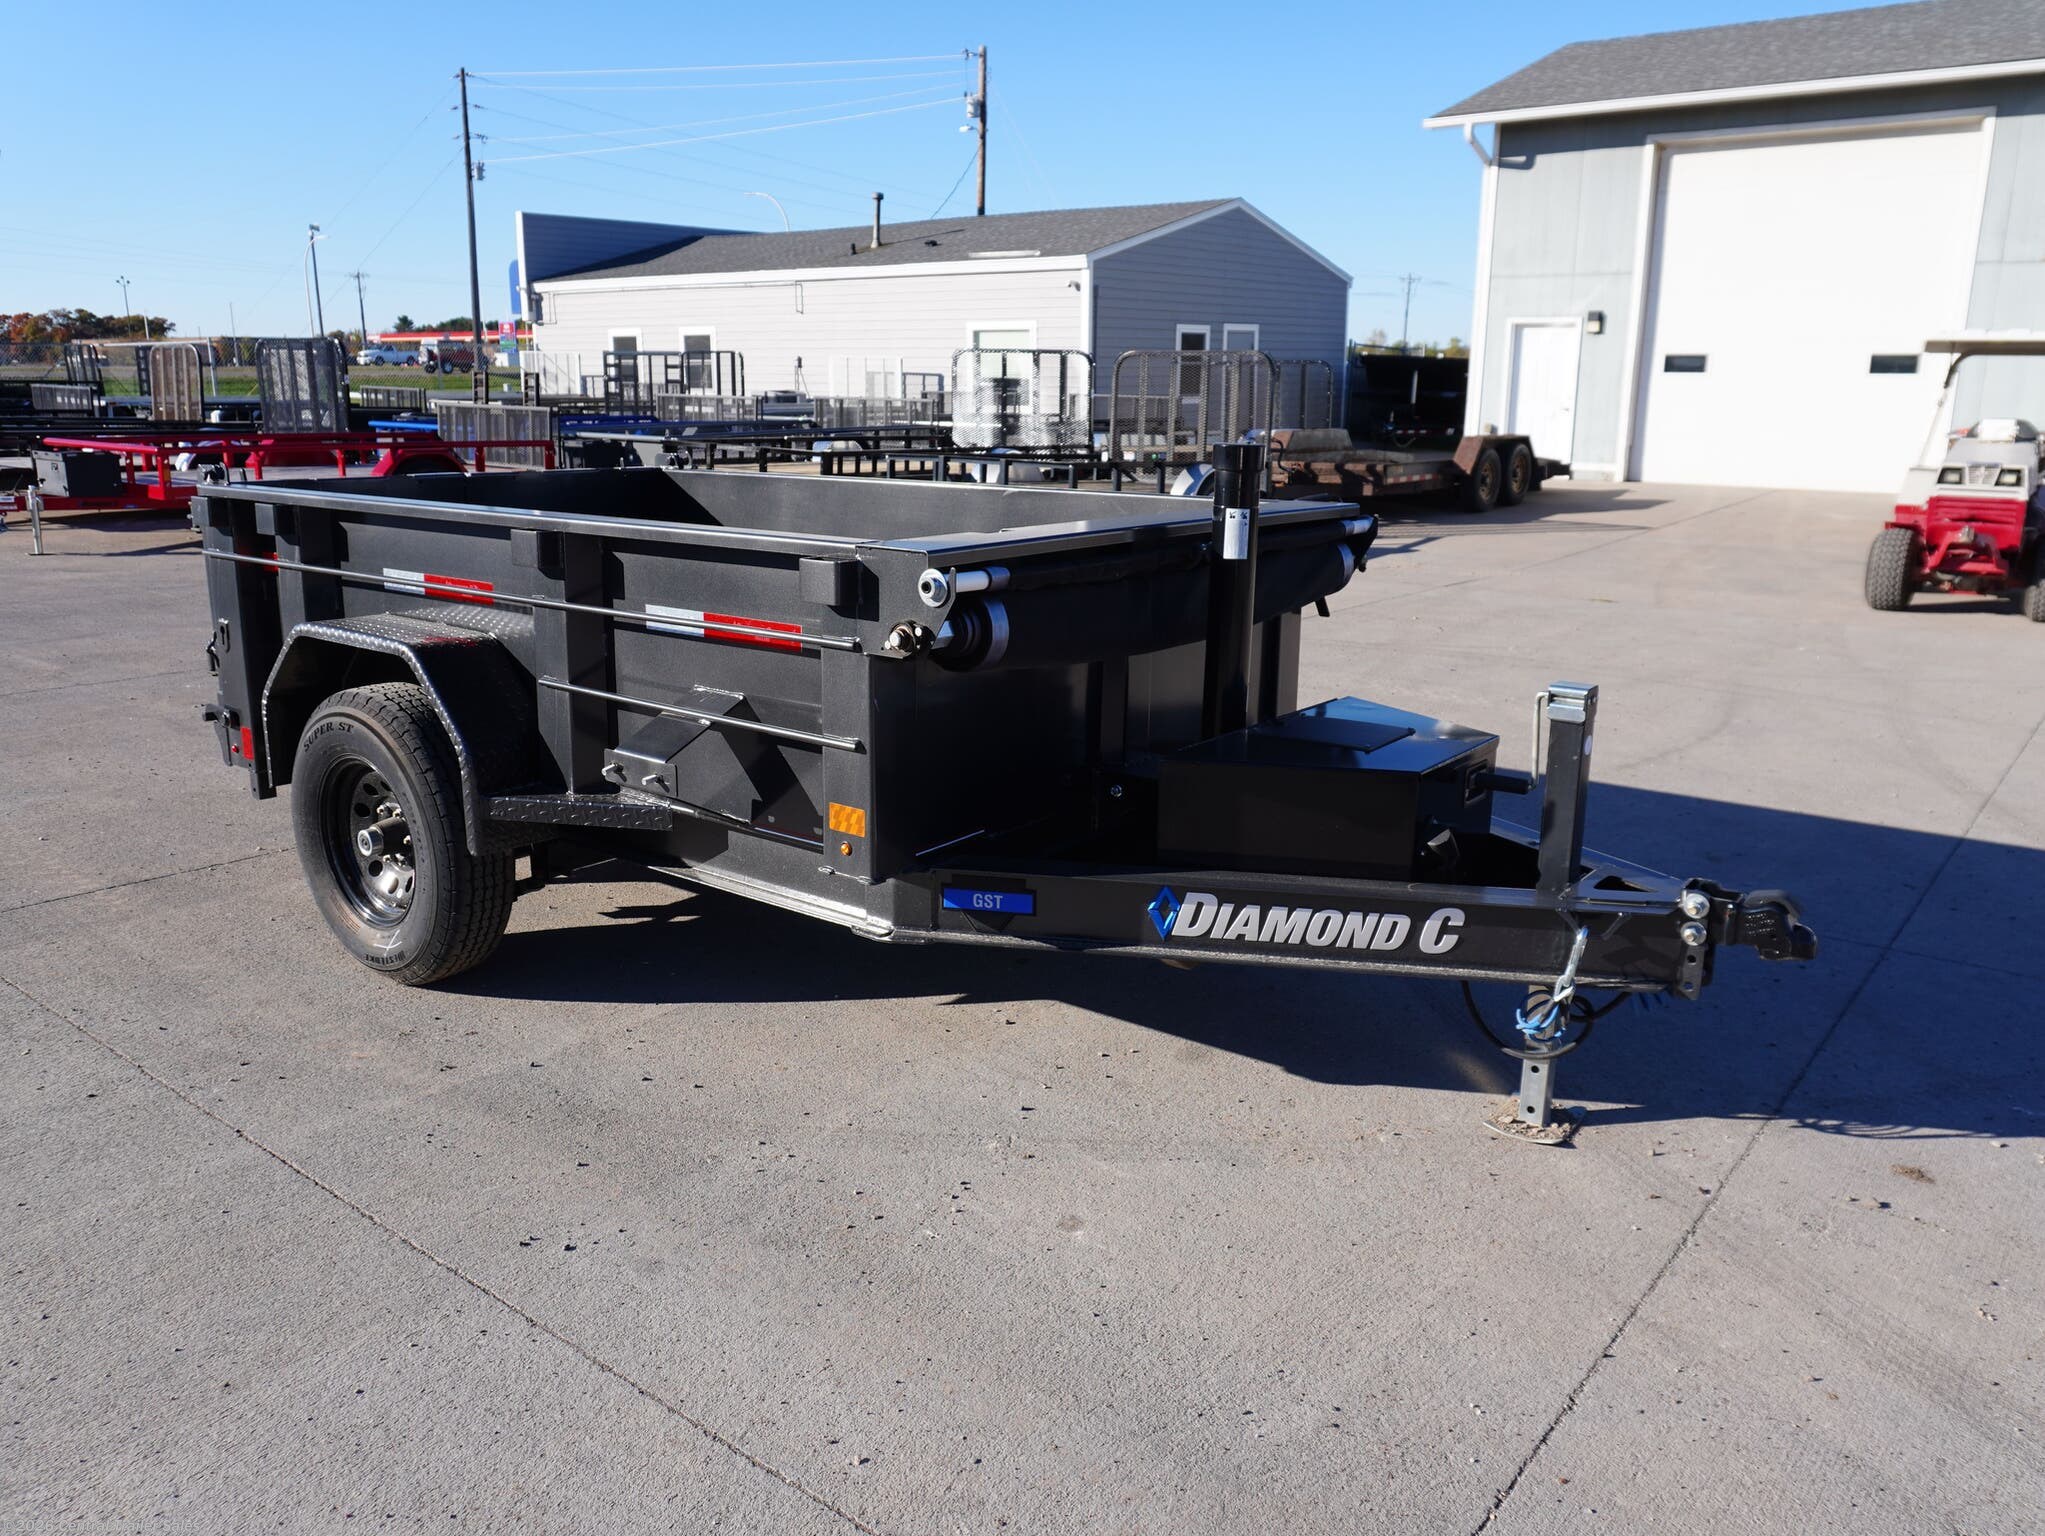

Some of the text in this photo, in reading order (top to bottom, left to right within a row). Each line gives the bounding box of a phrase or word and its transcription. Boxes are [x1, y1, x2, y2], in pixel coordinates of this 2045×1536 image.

[304, 722, 354, 752] SUPER ST
[973, 893, 1003, 909] GST
[1172, 892, 1465, 954] DIAMOND C
